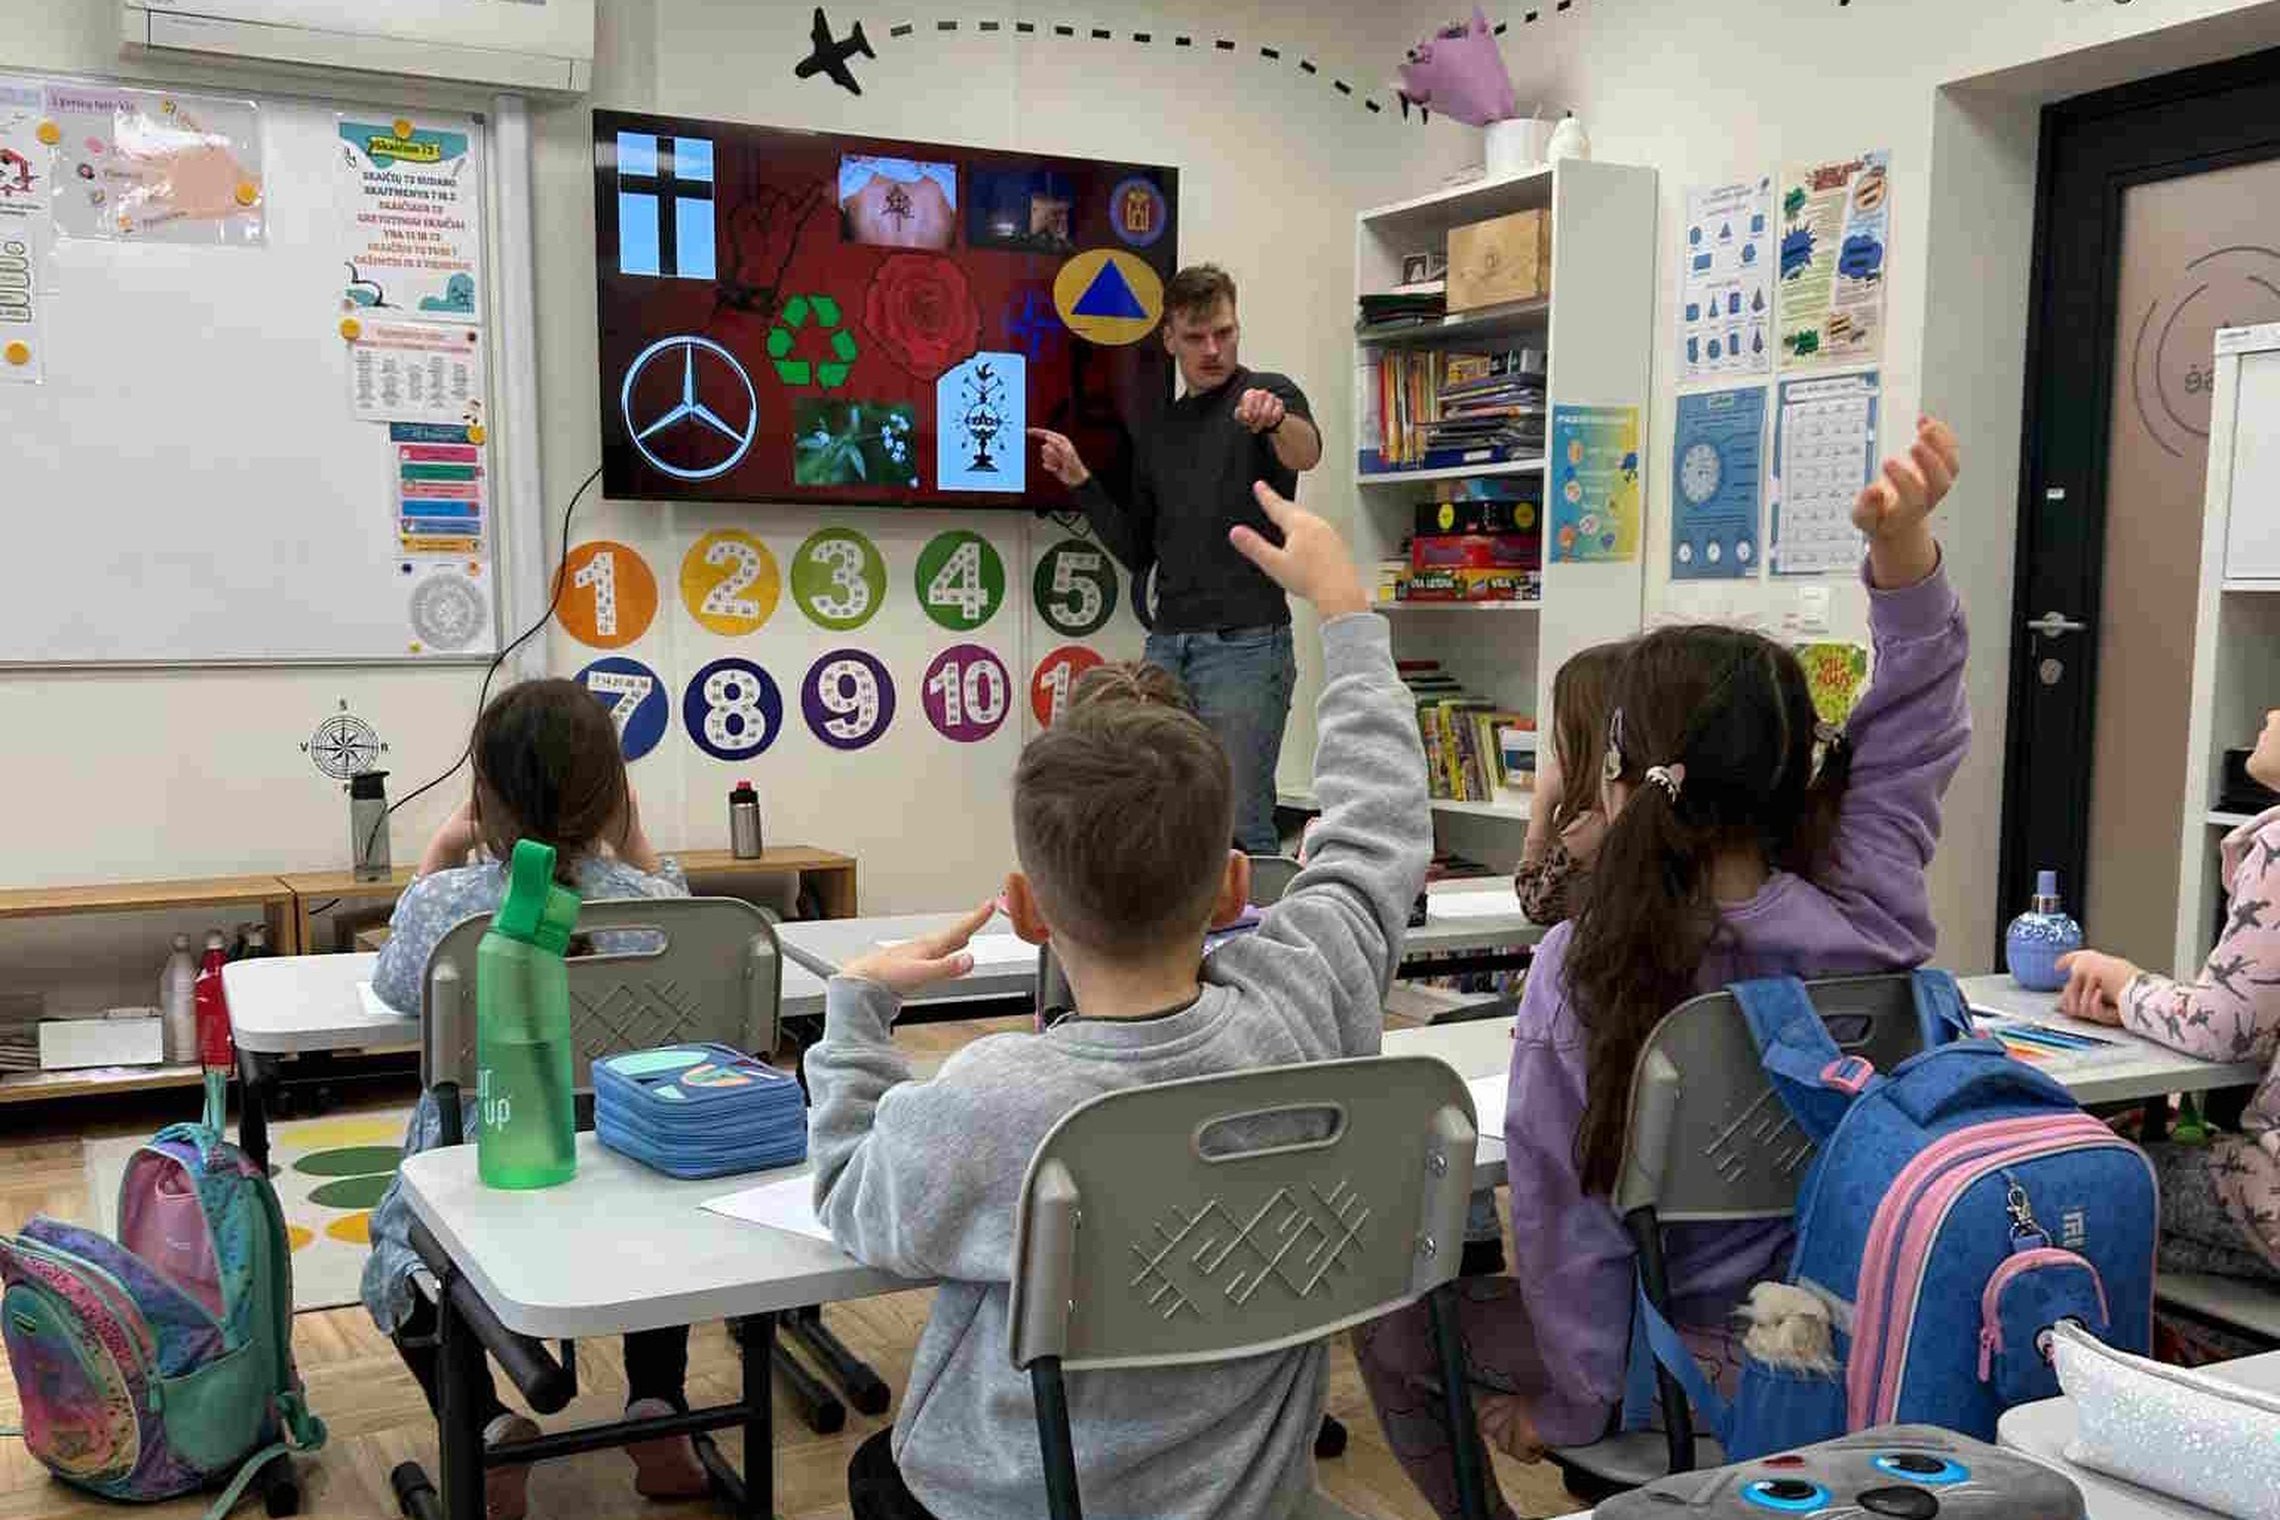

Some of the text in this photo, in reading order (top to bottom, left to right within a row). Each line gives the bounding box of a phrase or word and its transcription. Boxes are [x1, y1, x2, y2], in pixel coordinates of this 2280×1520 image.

[574, 551, 618, 636] 1
[701, 541, 761, 618] 2
[810, 540, 869, 618] 3
[928, 542, 988, 620] 4
[1050, 552, 1101, 626] 5
[588, 670, 653, 750] 7
[703, 669, 766, 750] 8
[819, 660, 879, 739] 9
[929, 660, 1003, 725] 10
[300, 742, 308, 752] V
